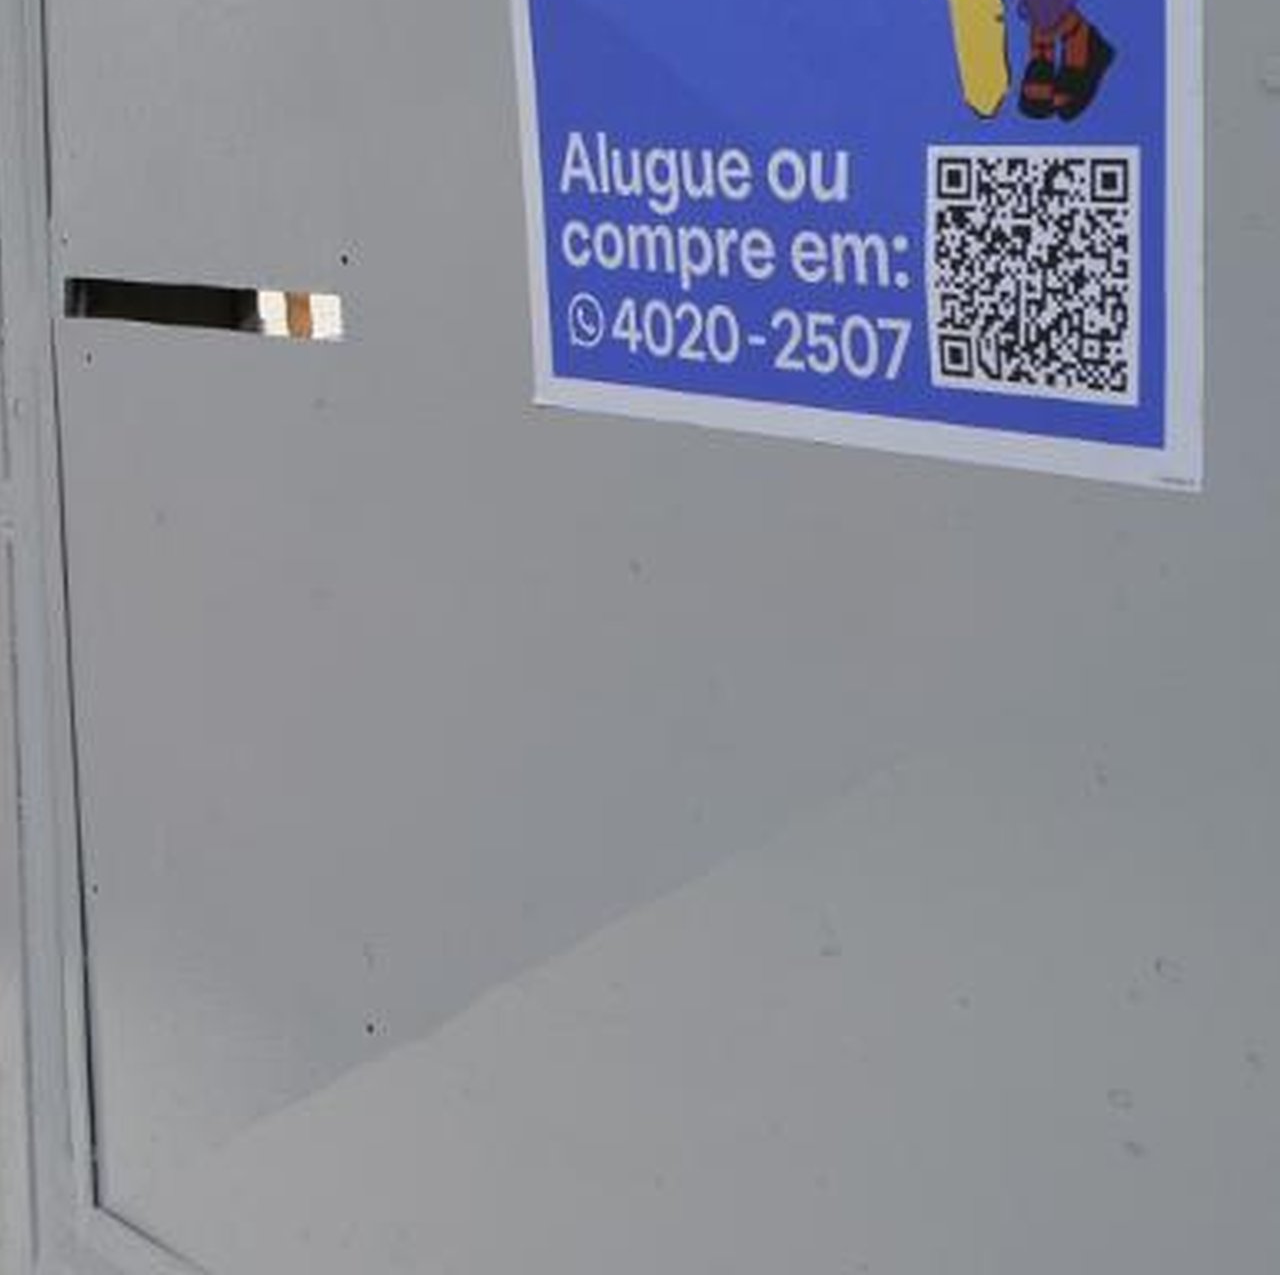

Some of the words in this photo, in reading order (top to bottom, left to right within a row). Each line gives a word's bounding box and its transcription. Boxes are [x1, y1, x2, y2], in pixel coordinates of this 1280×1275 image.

[559, 131, 752, 215] Alugue
[766, 147, 849, 203] ou
[561, 221, 776, 291] compre
[790, 230, 911, 288] em:
